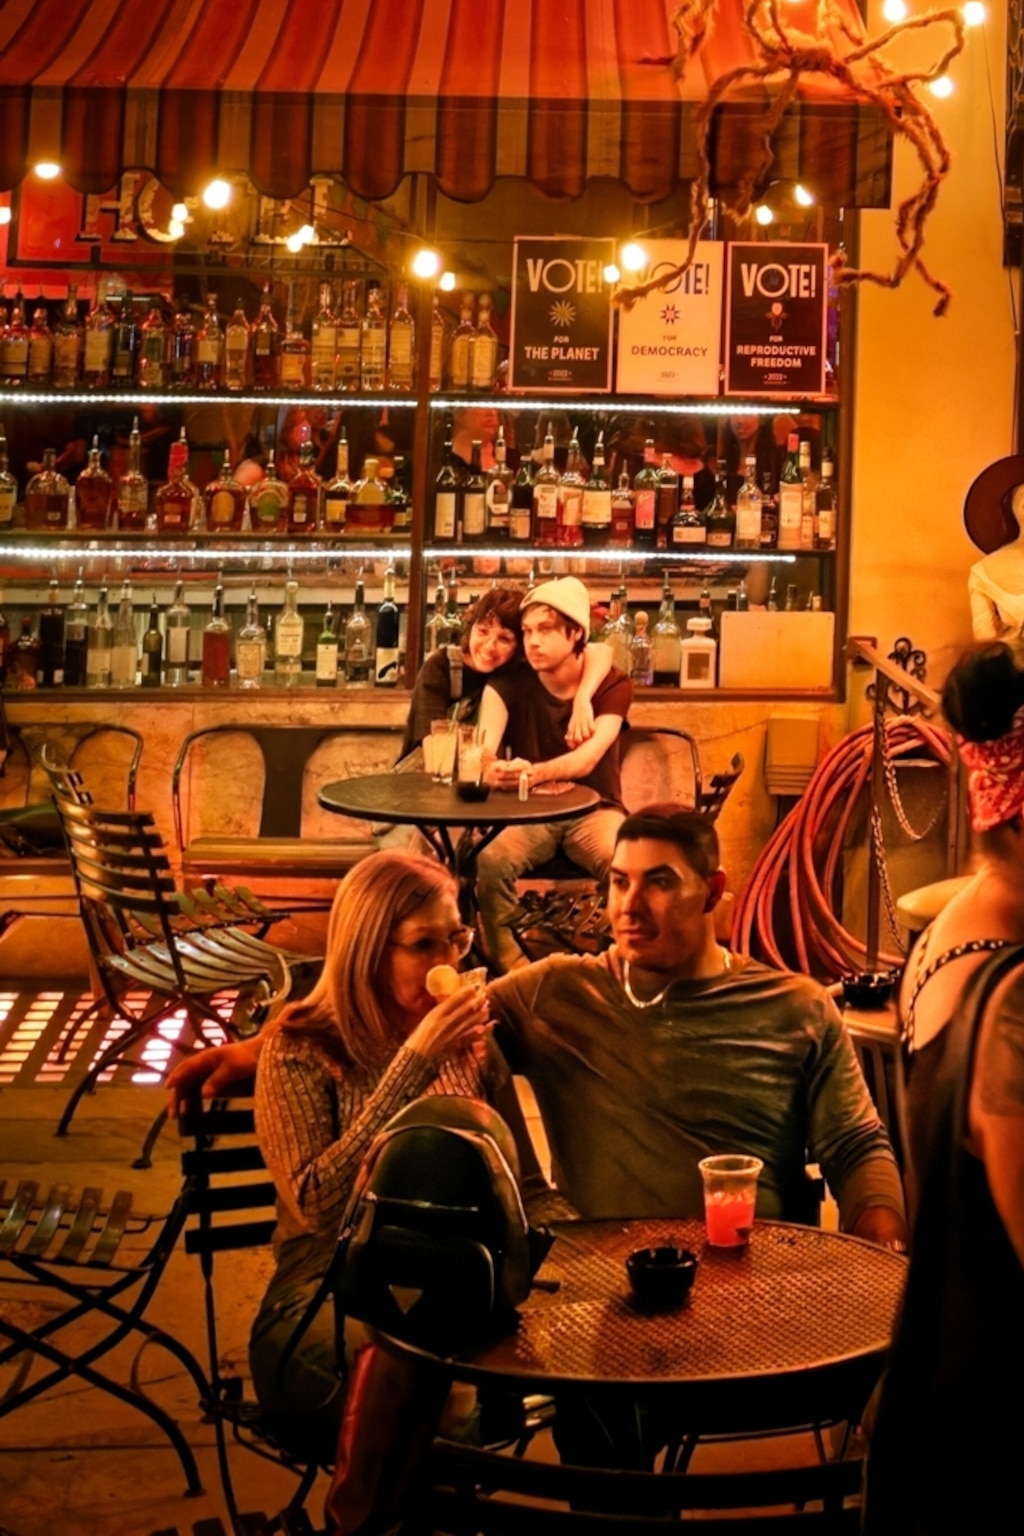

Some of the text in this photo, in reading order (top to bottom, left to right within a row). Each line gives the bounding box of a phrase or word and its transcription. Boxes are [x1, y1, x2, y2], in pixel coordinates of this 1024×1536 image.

[526, 258, 604, 294] VOTE!
[741, 263, 817, 298] VOTE!
[553, 335, 570, 343] FOR
[524, 345, 600, 361] THE PLANET
[631, 345, 709, 357] DEMOCRACY
[736, 345, 817, 356] REPRODUCTIVE
[751, 357, 803, 368] FREEDOM
